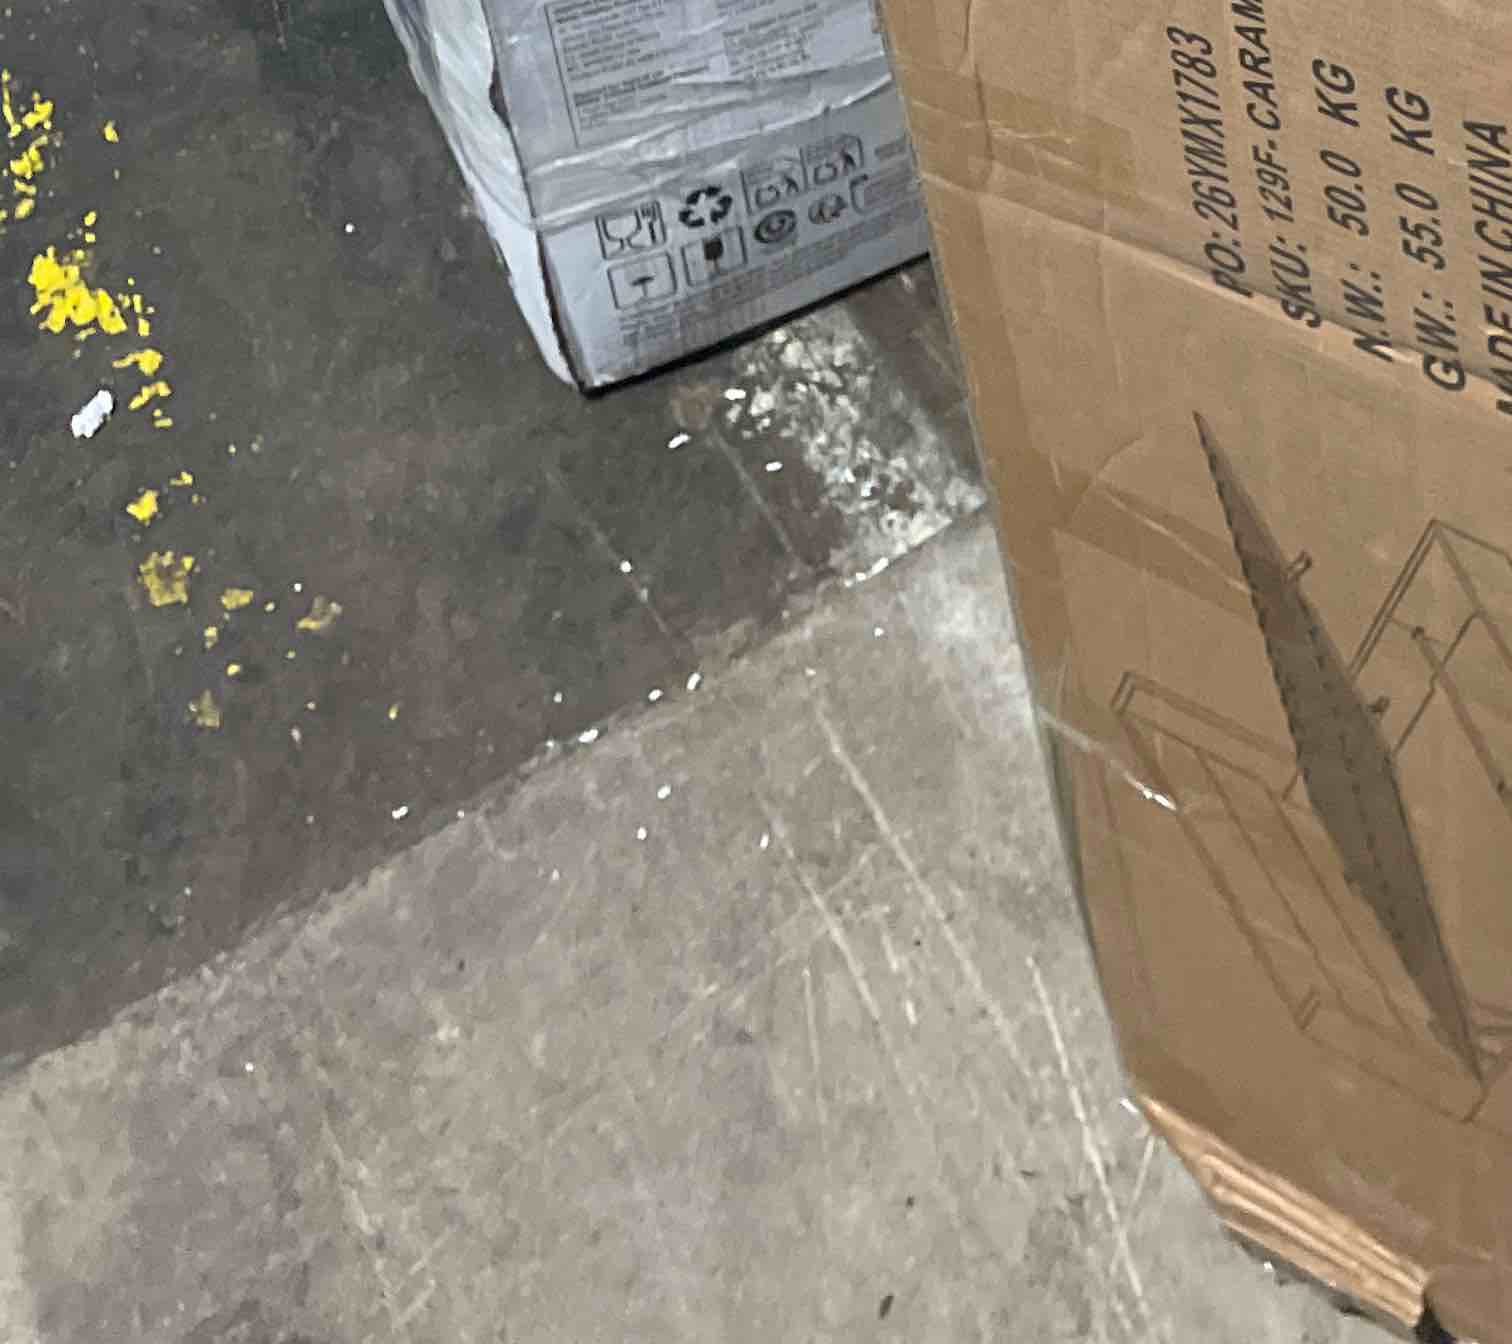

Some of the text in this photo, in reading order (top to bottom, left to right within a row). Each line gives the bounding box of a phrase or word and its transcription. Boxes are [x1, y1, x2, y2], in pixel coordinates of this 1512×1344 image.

[1312, 58, 1360, 128] KG
[1384, 86, 1435, 156] KG
[1319, 149, 1370, 237] 50.0
[1395, 182, 1446, 271] 55.0
[1268, 234, 1322, 329] SKU:
